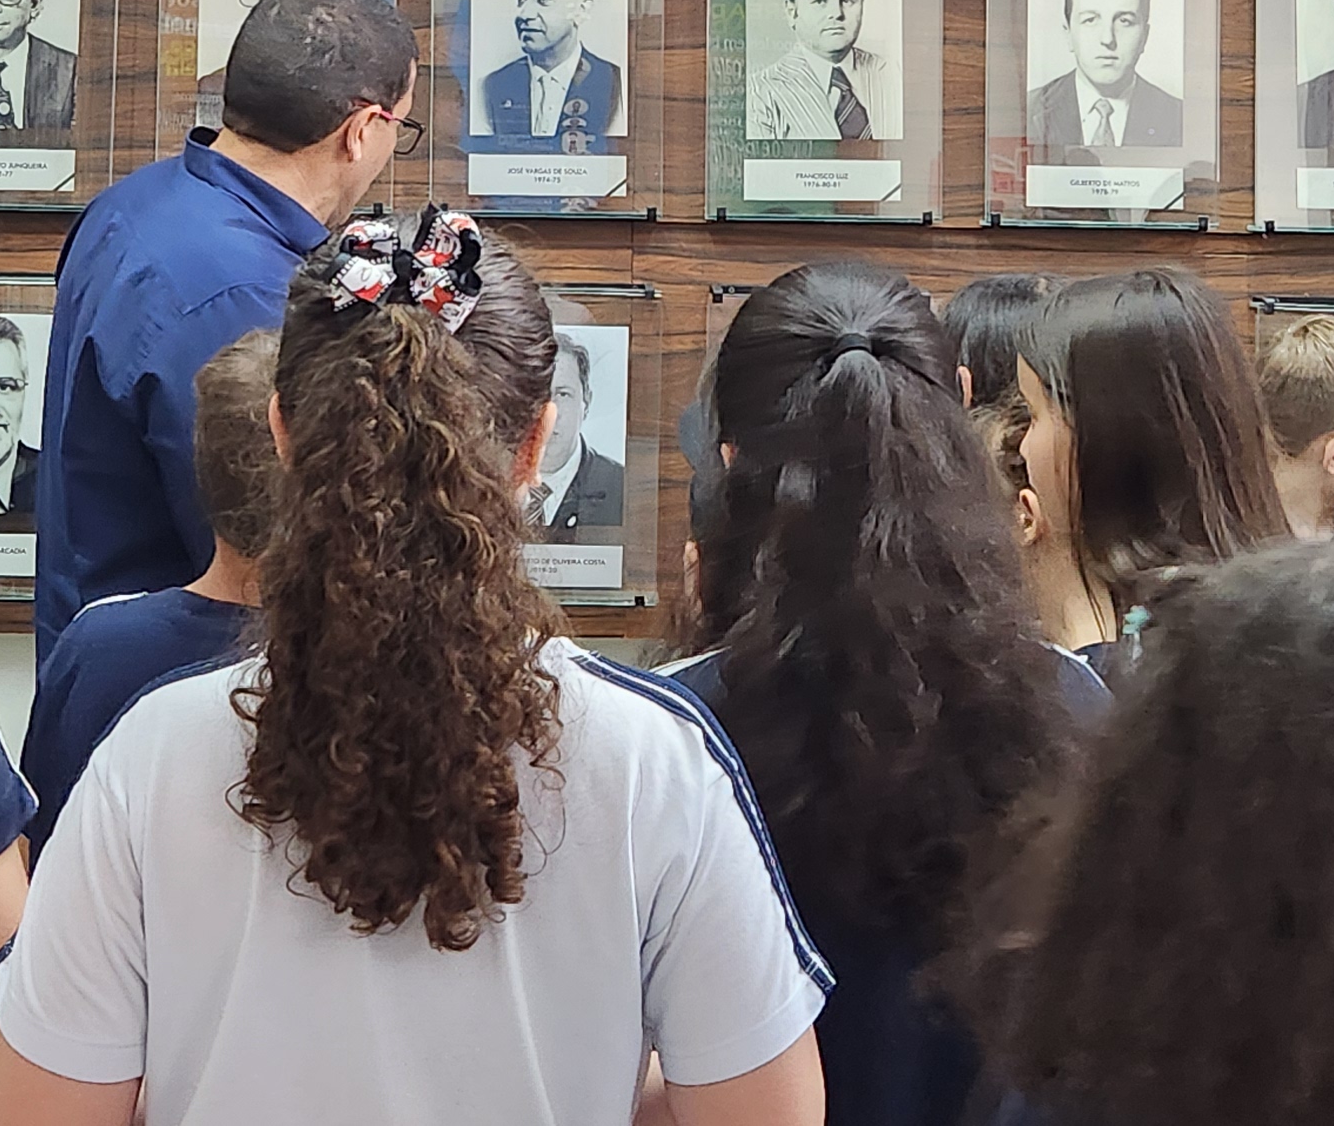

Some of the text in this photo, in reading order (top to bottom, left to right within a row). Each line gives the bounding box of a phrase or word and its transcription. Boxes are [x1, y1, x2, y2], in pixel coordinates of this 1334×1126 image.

[507, 167, 523, 175] JOSÉ
[563, 168, 587, 176] SOUZA
[1114, 180, 1140, 188] MATTOS
[541, 558, 552, 566] DE
[583, 559, 606, 567] COSTA
